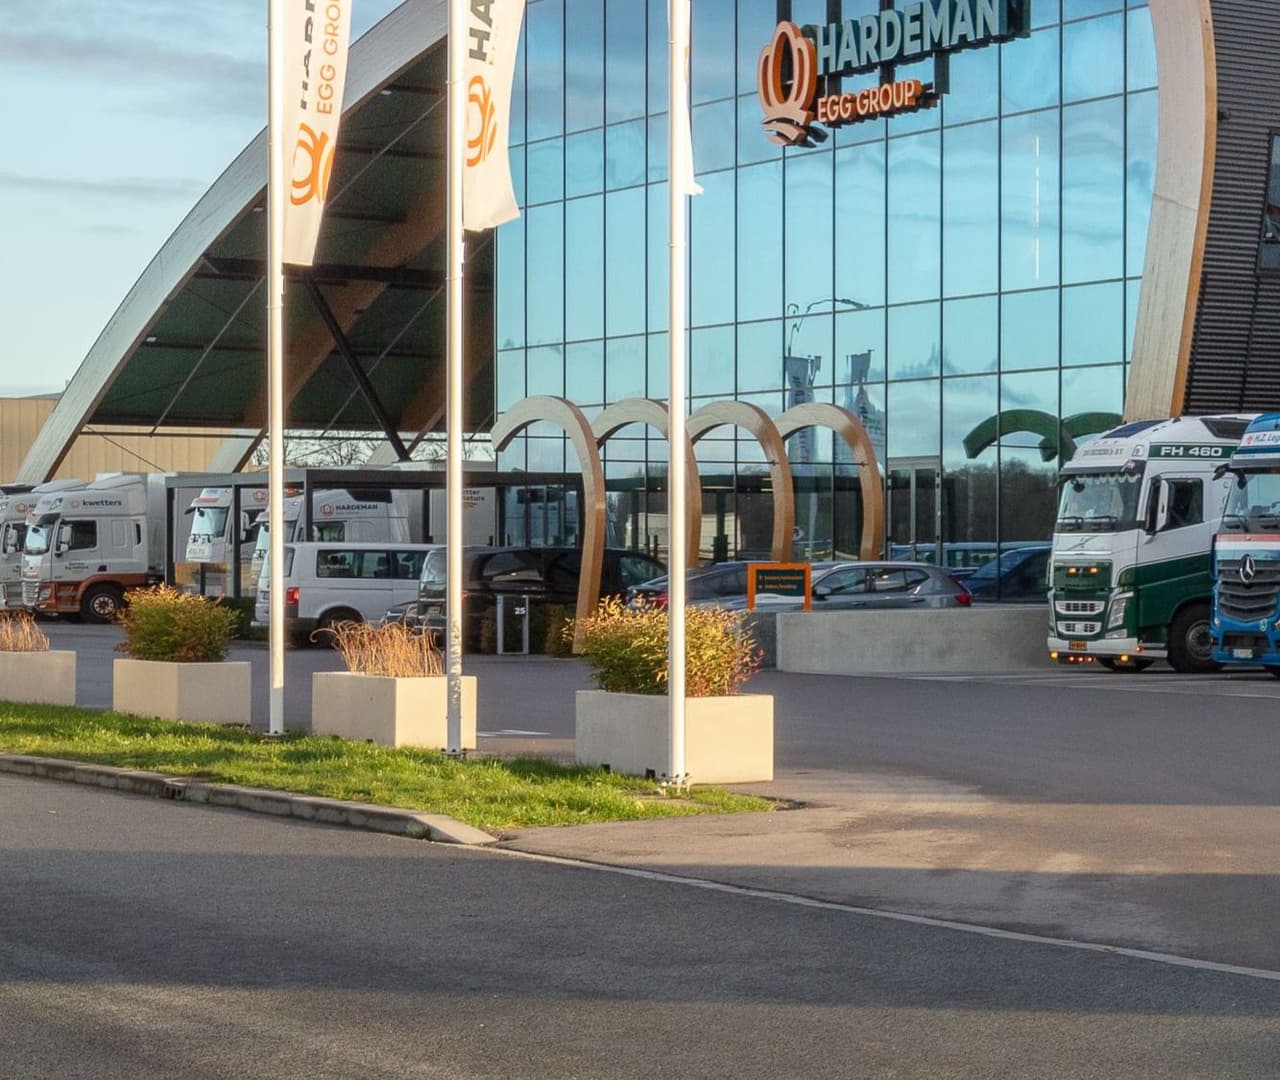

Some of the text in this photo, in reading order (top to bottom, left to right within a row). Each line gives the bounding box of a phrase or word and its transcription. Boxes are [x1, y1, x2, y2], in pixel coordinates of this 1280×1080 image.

[317, 63, 336, 115] EGG
[817, 79, 920, 123] EGG GROUP
[1160, 446, 1223, 457] FH 460
[82, 499, 123, 507] kwetters
[514, 607, 526, 615] 25
